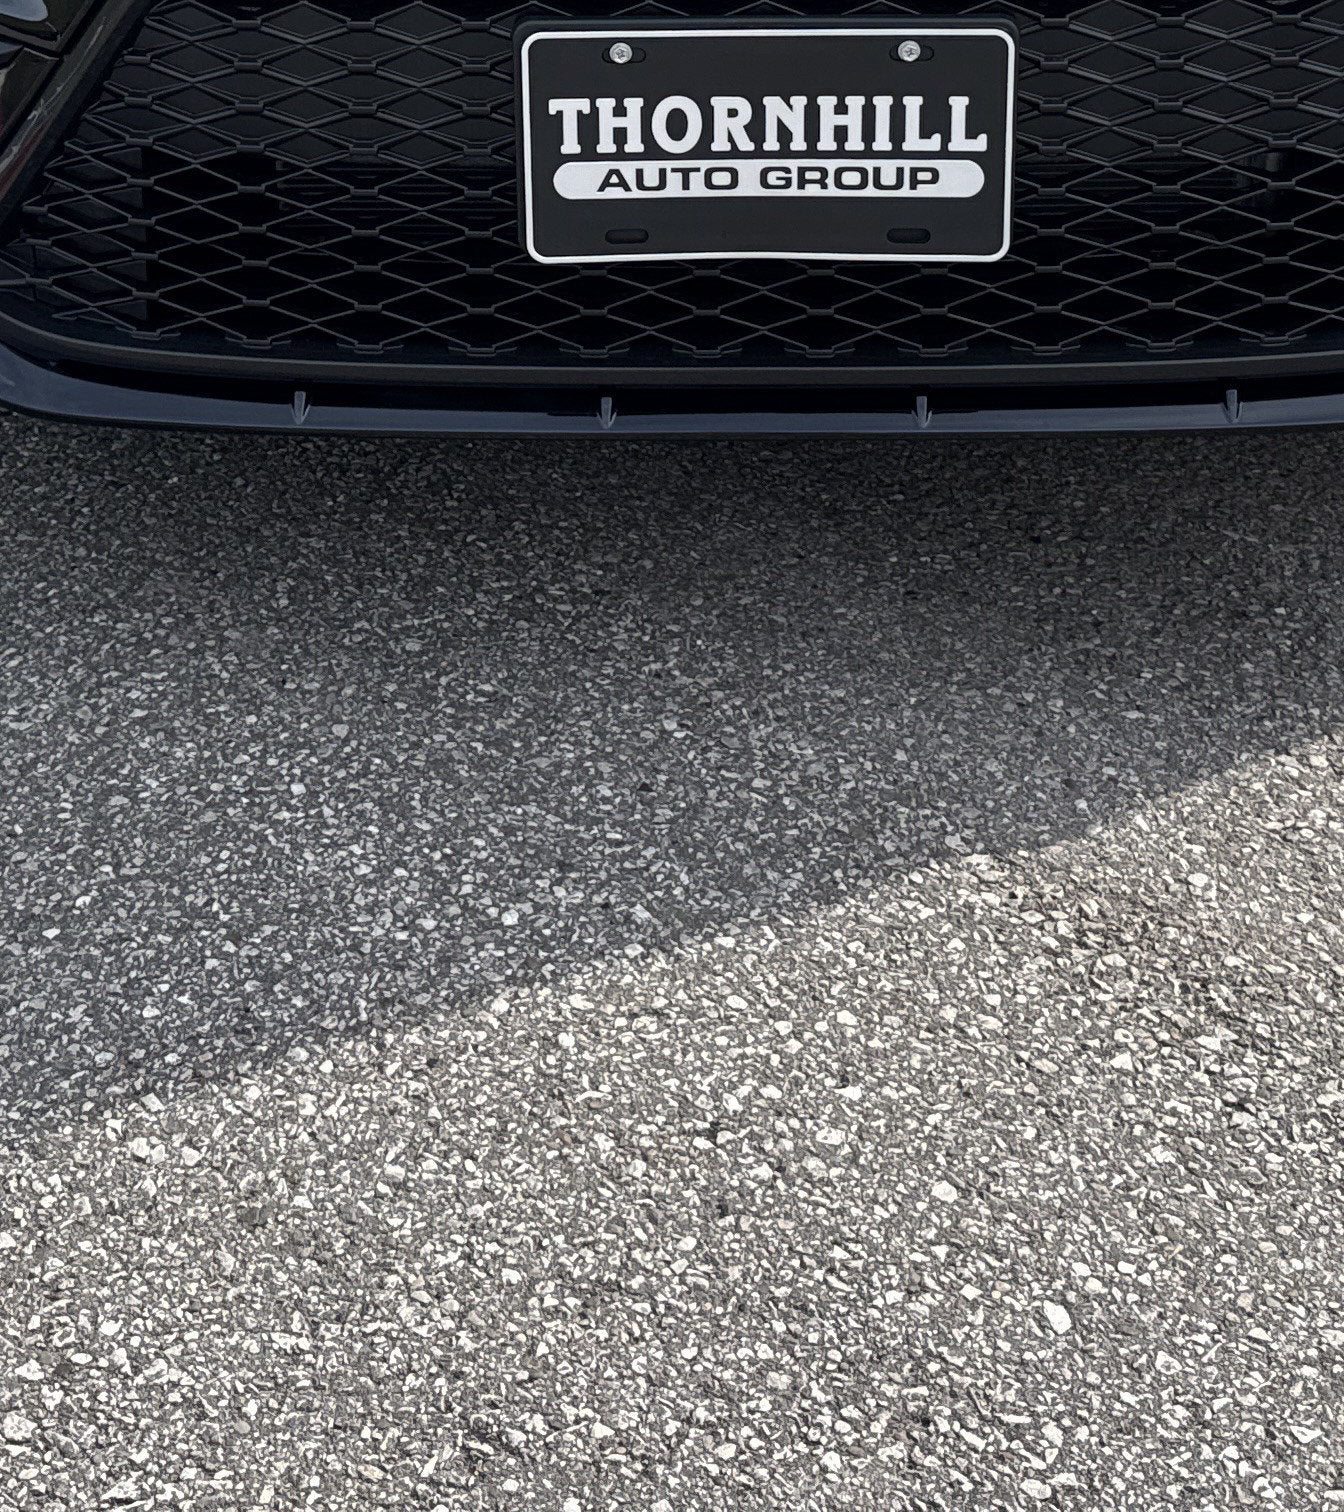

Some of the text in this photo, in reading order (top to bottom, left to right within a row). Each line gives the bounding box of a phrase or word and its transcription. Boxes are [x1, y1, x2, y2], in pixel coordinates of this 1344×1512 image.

[548, 95, 988, 155] THORNHILL
[597, 166, 940, 192] AUTO GROUP
